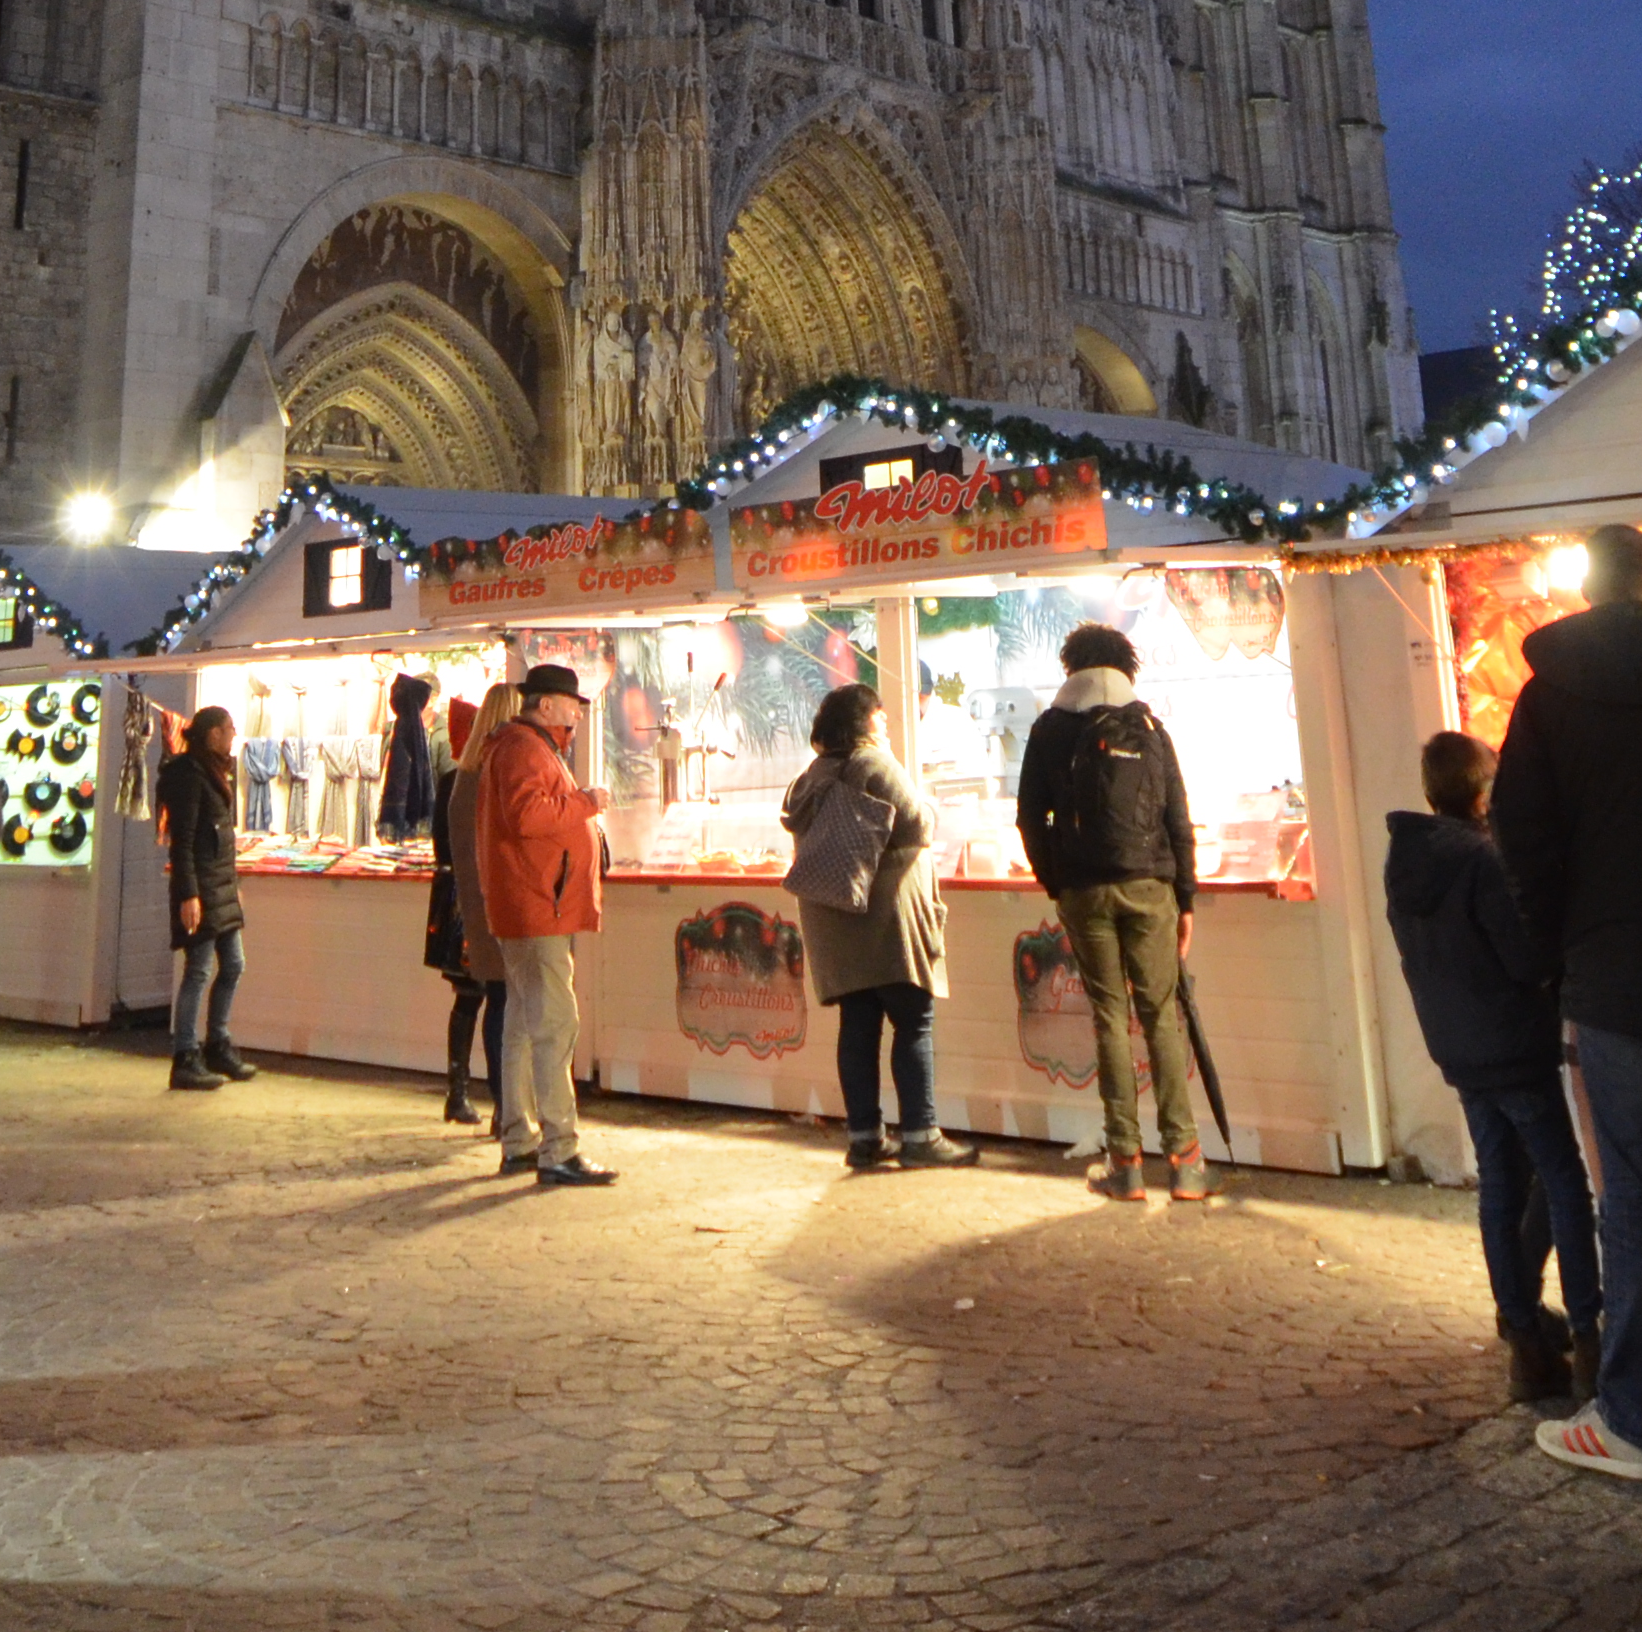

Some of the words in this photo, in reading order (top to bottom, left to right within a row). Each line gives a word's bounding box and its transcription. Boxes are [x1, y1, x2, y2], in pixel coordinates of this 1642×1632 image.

[814, 459, 991, 533] Milot
[504, 513, 603, 572] Milot
[747, 537, 940, 578] Croustillons
[951, 516, 1087, 556] Chichis
[449, 576, 546, 605] Gaufres
[578, 563, 677, 594] Crêpes
[699, 982, 795, 1011] Croustillons
